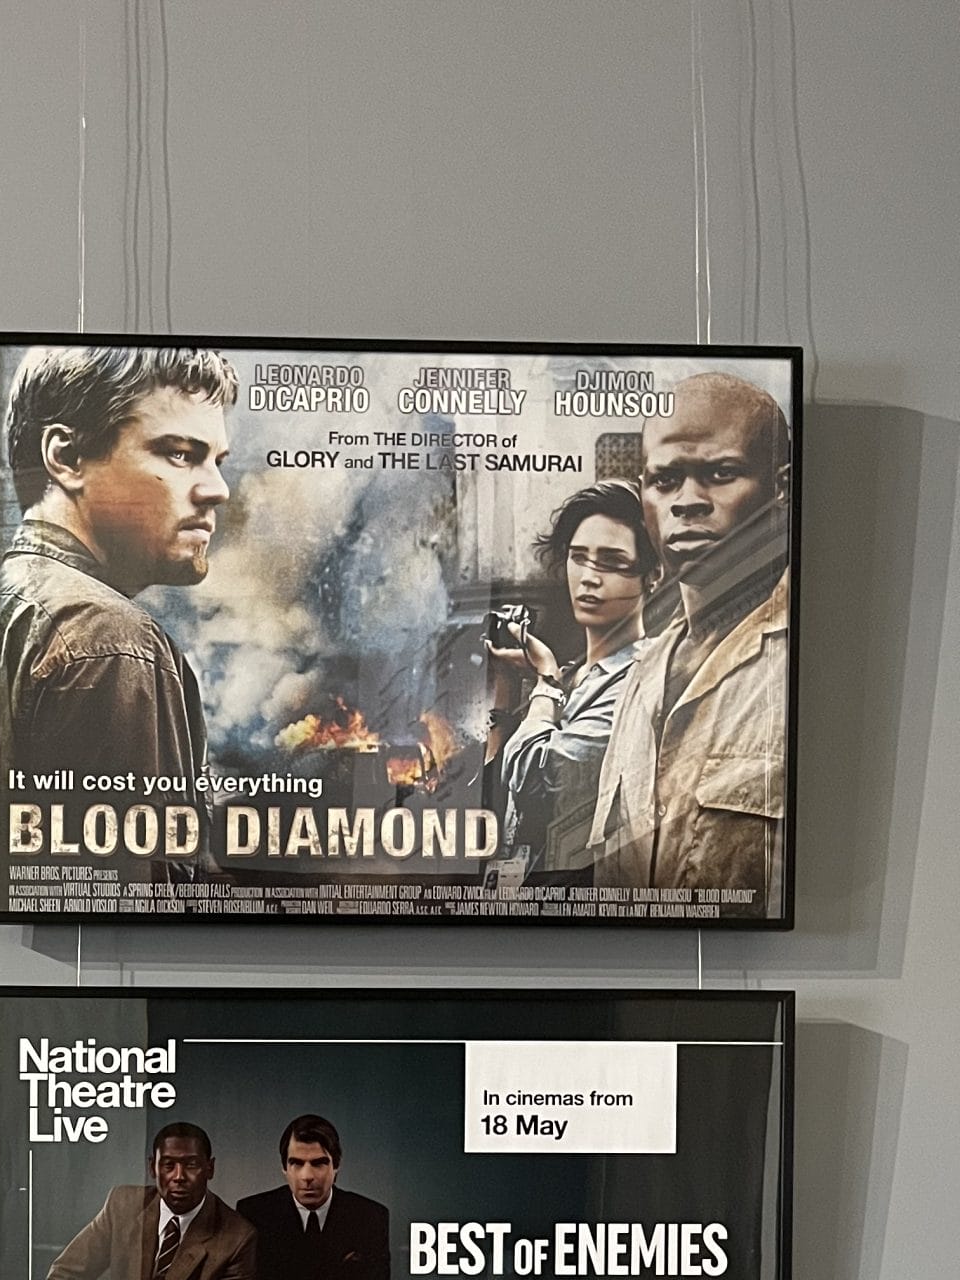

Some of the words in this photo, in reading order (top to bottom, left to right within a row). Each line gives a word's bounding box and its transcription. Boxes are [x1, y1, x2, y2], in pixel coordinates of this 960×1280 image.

[255, 364, 364, 387] LEONARDO
[414, 367, 511, 390] JENNIFER
[576, 371, 654, 392] DJIMON
[398, 388, 527, 415] CONNELLY
[554, 391, 676, 418] HOUNSOU
[328, 431, 369, 446] From
[374, 432, 407, 447] THE
[411, 433, 498, 448] DIRECTOR
[501, 434, 518, 449] of
[266, 451, 340, 469] GLORY
[344, 454, 374, 470] and
[378, 453, 420, 470] THE
[425, 454, 480, 472] LAST
[484, 455, 583, 473] SAMURAI
[8, 769, 25, 790] It
[33, 770, 75, 791] will
[81, 772, 137, 792] cost
[143, 775, 188, 797] you
[196, 772, 324, 797] everything
[8, 803, 200, 858] BLOOD
[226, 805, 500, 859] DIAMOND
[9, 865, 40, 880] WARNER
[61, 866, 92, 881] PICTURES
[63, 883, 92, 897] VIRTUAL
[92, 883, 121, 897] STUDIOS
[128, 883, 153, 897] SPRING
[210, 884, 231, 898] FALLS
[320, 884, 342, 899] INITIAL
[344, 885, 398, 899] ENTERTAINMENT
[399, 885, 422, 899] GROUP
[433, 885, 462, 900] EDWARD
[463, 886, 484, 900] ZWICK
[499, 886, 534, 900] LEONARDO
[568, 887, 598, 901] JENNIFER
[600, 887, 631, 901] CONNELLY
[633, 888, 660, 902] DJIMON
[661, 888, 692, 902] HOUNSOU
[9, 898, 39, 912] MICHAEL
[40, 898, 61, 912] SHEEN
[63, 898, 91, 912] ARNOLD
[92, 899, 118, 912] VOSLOO
[198, 899, 222, 913] STEVEN
[302, 900, 317, 914] DAN
[360, 900, 391, 915] EDUARDO
[456, 901, 479, 916] JAMES
[480, 902, 508, 916] NEWTON
[509, 902, 539, 916] HOWARD
[599, 903, 617, 917] KEVIN
[650, 904, 684, 918] BENJAMIN
[19, 1038, 176, 1073] National
[19, 1073, 176, 1108] Theatre
[482, 1089, 500, 1106] In
[505, 1090, 584, 1107] cinemas
[589, 1090, 633, 1107] from
[29, 1107, 108, 1143] Live
[481, 1114, 508, 1136] 18
[516, 1115, 568, 1140] May
[410, 1221, 511, 1276] BEST
[513, 1238, 549, 1276] OF
[554, 1222, 729, 1277] ENEMIES
